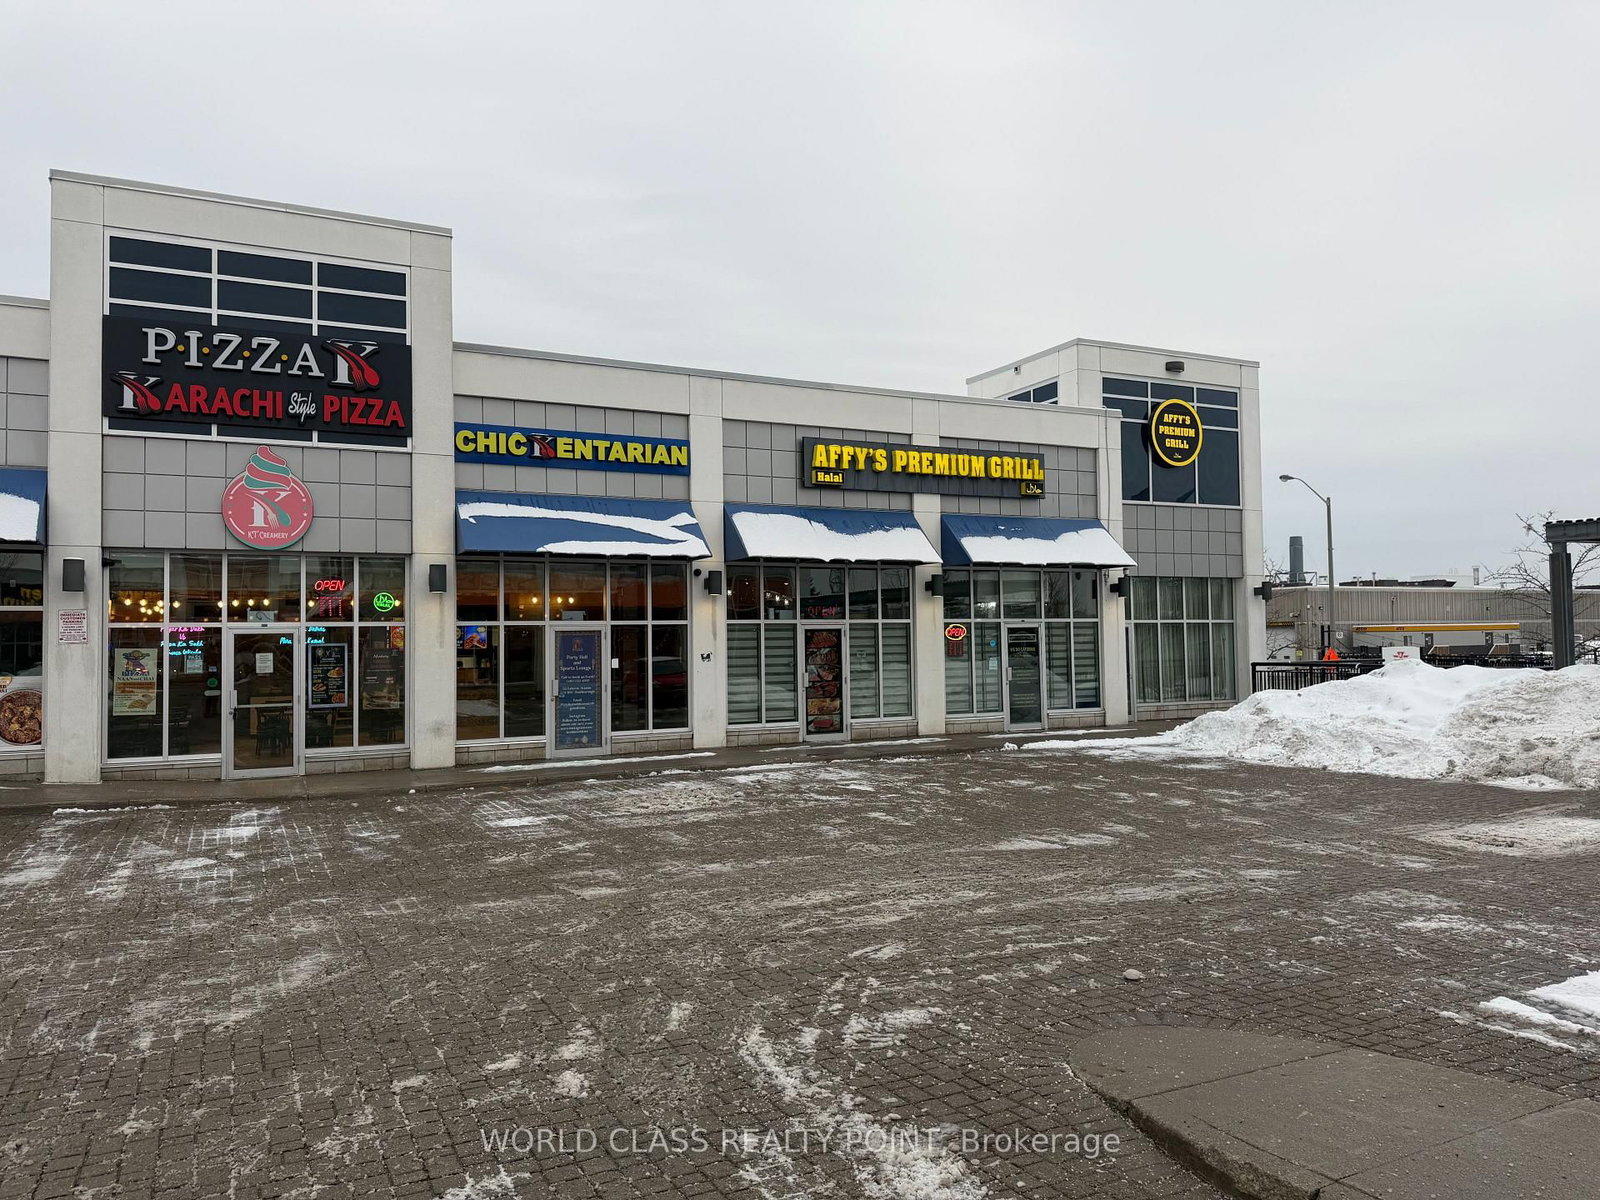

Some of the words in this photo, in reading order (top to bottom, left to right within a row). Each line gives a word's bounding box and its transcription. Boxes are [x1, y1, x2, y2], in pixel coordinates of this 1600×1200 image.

[114, 370, 283, 419] KARACHI
[288, 391, 317, 422] Style
[323, 394, 405, 427] PIZZA
[1163, 413, 1191, 425] AFFY'S
[1158, 425, 1196, 437] PREMIUM
[455, 429, 688, 466] CHICKENTARIAN
[1165, 438, 1189, 449] GRILL
[812, 444, 888, 472] AFFY'S
[892, 450, 986, 478] PREMIUM
[987, 456, 1045, 480] GRILL
[817, 472, 843, 483] Halal
[314, 580, 345, 591] OPEN
[947, 628, 965, 637] OPEN
